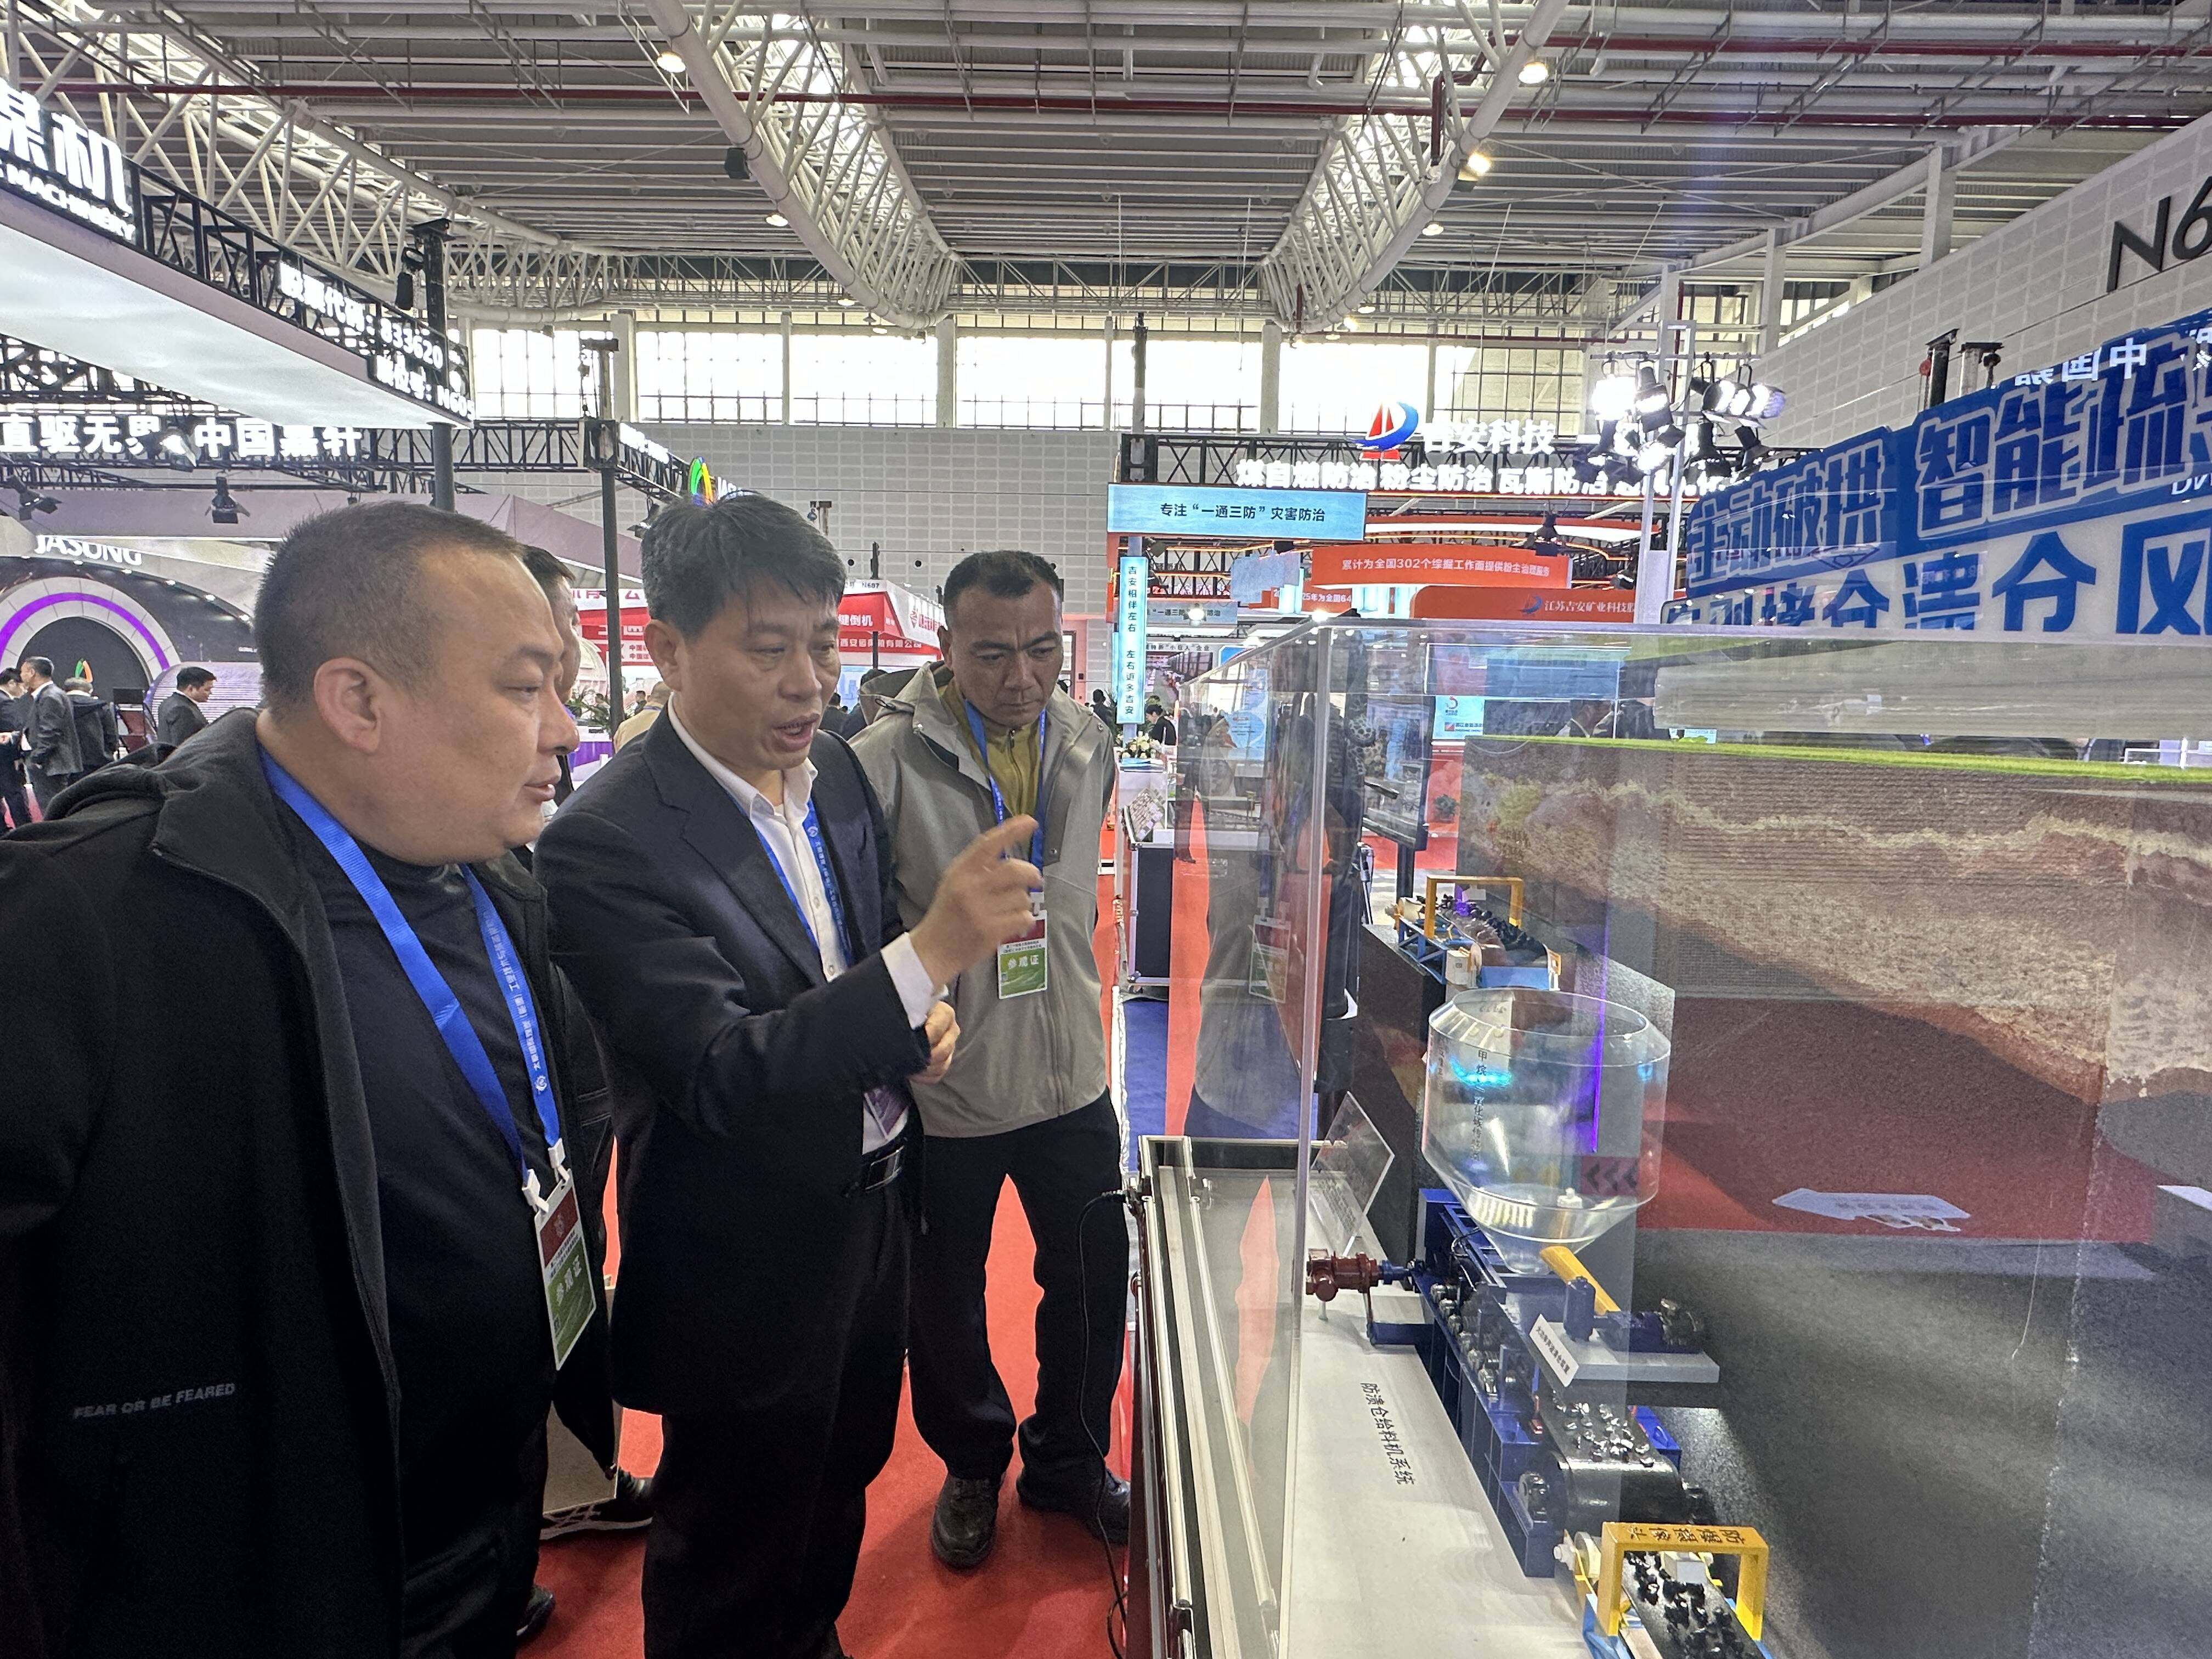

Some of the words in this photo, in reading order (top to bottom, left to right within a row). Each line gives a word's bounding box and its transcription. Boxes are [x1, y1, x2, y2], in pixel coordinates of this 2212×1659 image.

[1380, 462, 1493, 493] 粉尘防治
[73, 1403, 117, 1419] FEAR
[121, 1400, 146, 1414] OR
[150, 1394, 172, 1409] BE
[176, 1383, 235, 1403] FEARED
[1361, 1383, 1414, 1485] 防溃仓给料机系统
